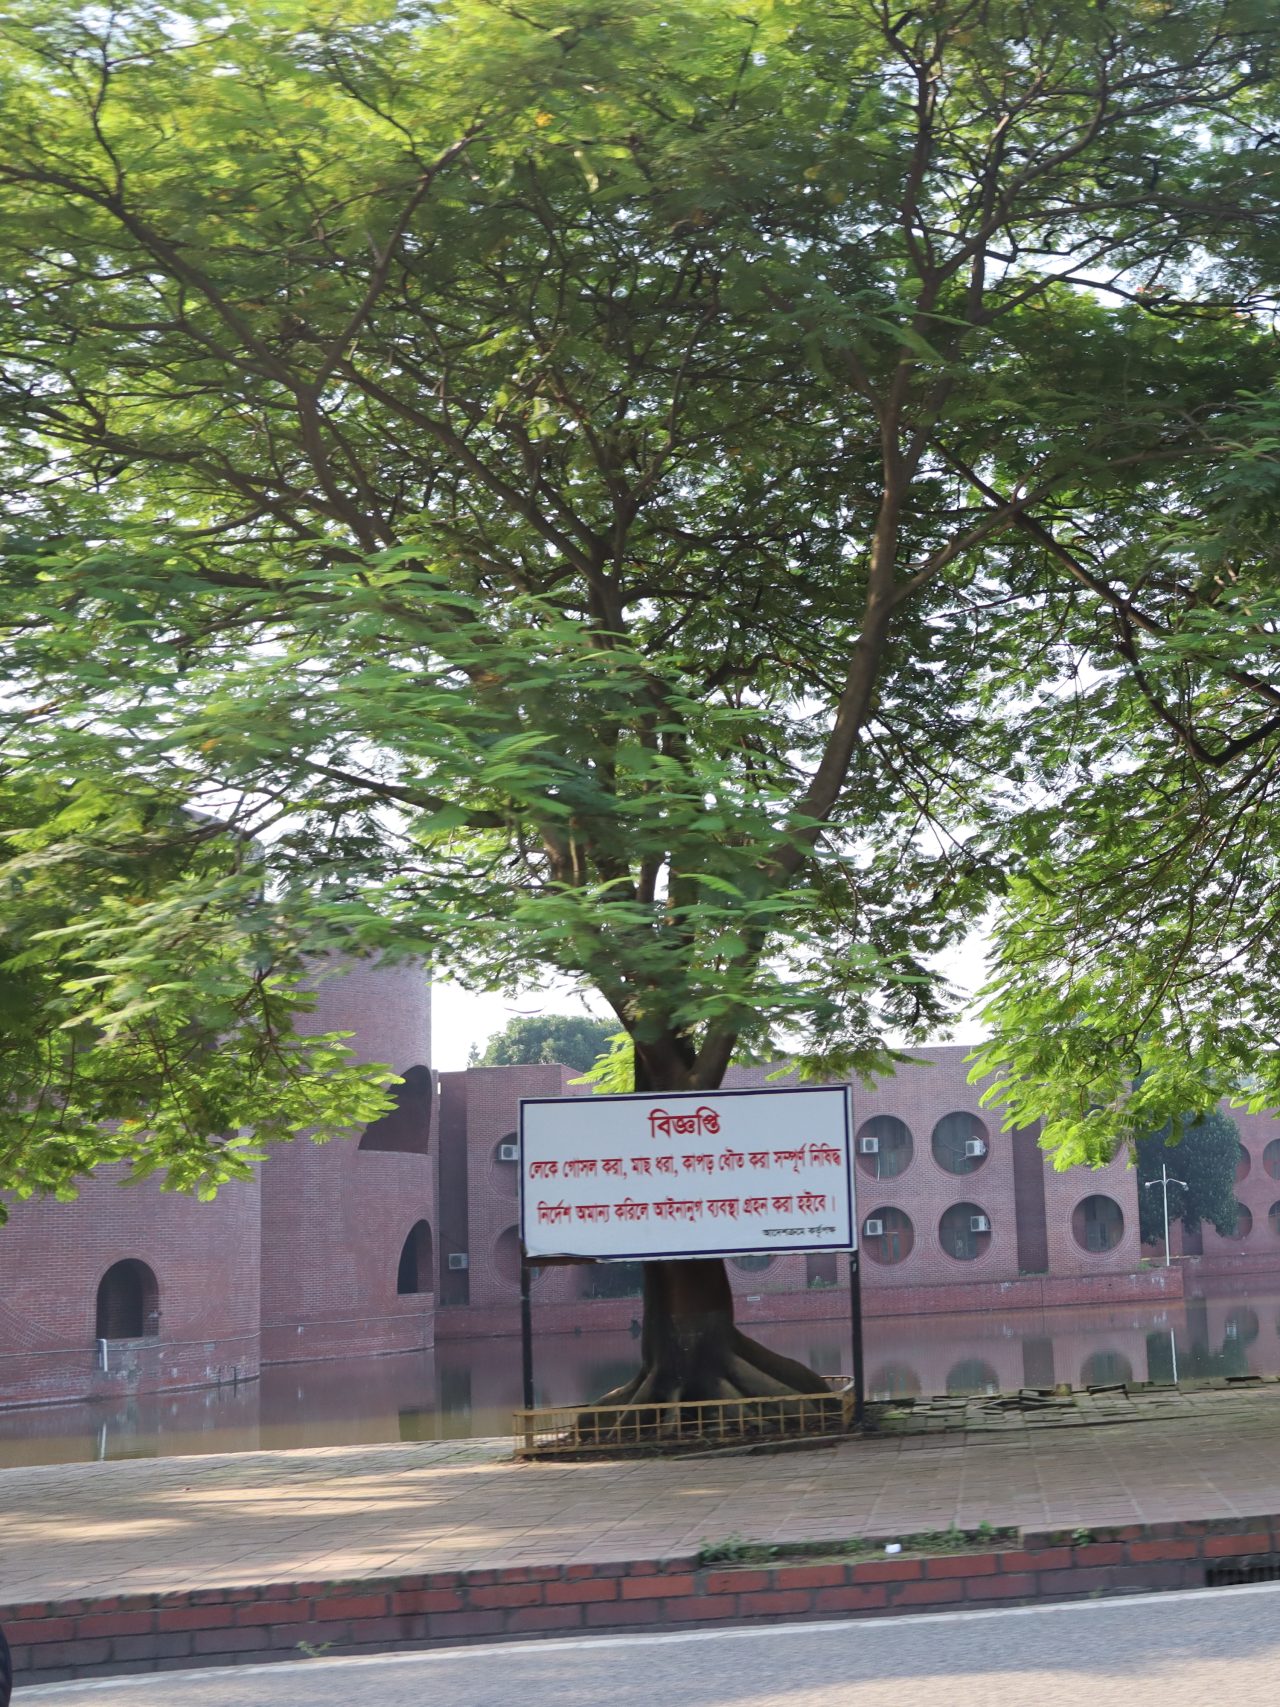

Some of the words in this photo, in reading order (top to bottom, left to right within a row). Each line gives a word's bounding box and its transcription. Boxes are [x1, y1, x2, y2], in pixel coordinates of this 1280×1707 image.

[647, 1106, 721, 1138] বিজ্ঞপ্তি
[530, 1160, 559, 1179] লেকে
[563, 1158, 598, 1179] গোসল
[601, 1158, 627, 1179] করা,
[631, 1157, 653, 1177] মাছ
[656, 1156, 679, 1177] ধরা,
[681, 1153, 714, 1175] কাপড়
[719, 1148, 745, 1171] ধৌত
[748, 1151, 770, 1170] করা
[773, 1142, 806, 1174] সম্পূর্ণ
[809, 1143, 841, 1167] নিষিদ্ধ
[537, 1199, 572, 1224] নির্দেশ
[575, 1203, 611, 1222] অমান্য
[614, 1197, 649, 1221] করিলে
[653, 1197, 703, 1222] আইনানুগ
[706, 1197, 740, 1221] ব্যবস্থা
[771, 1195, 793, 1215] করা
